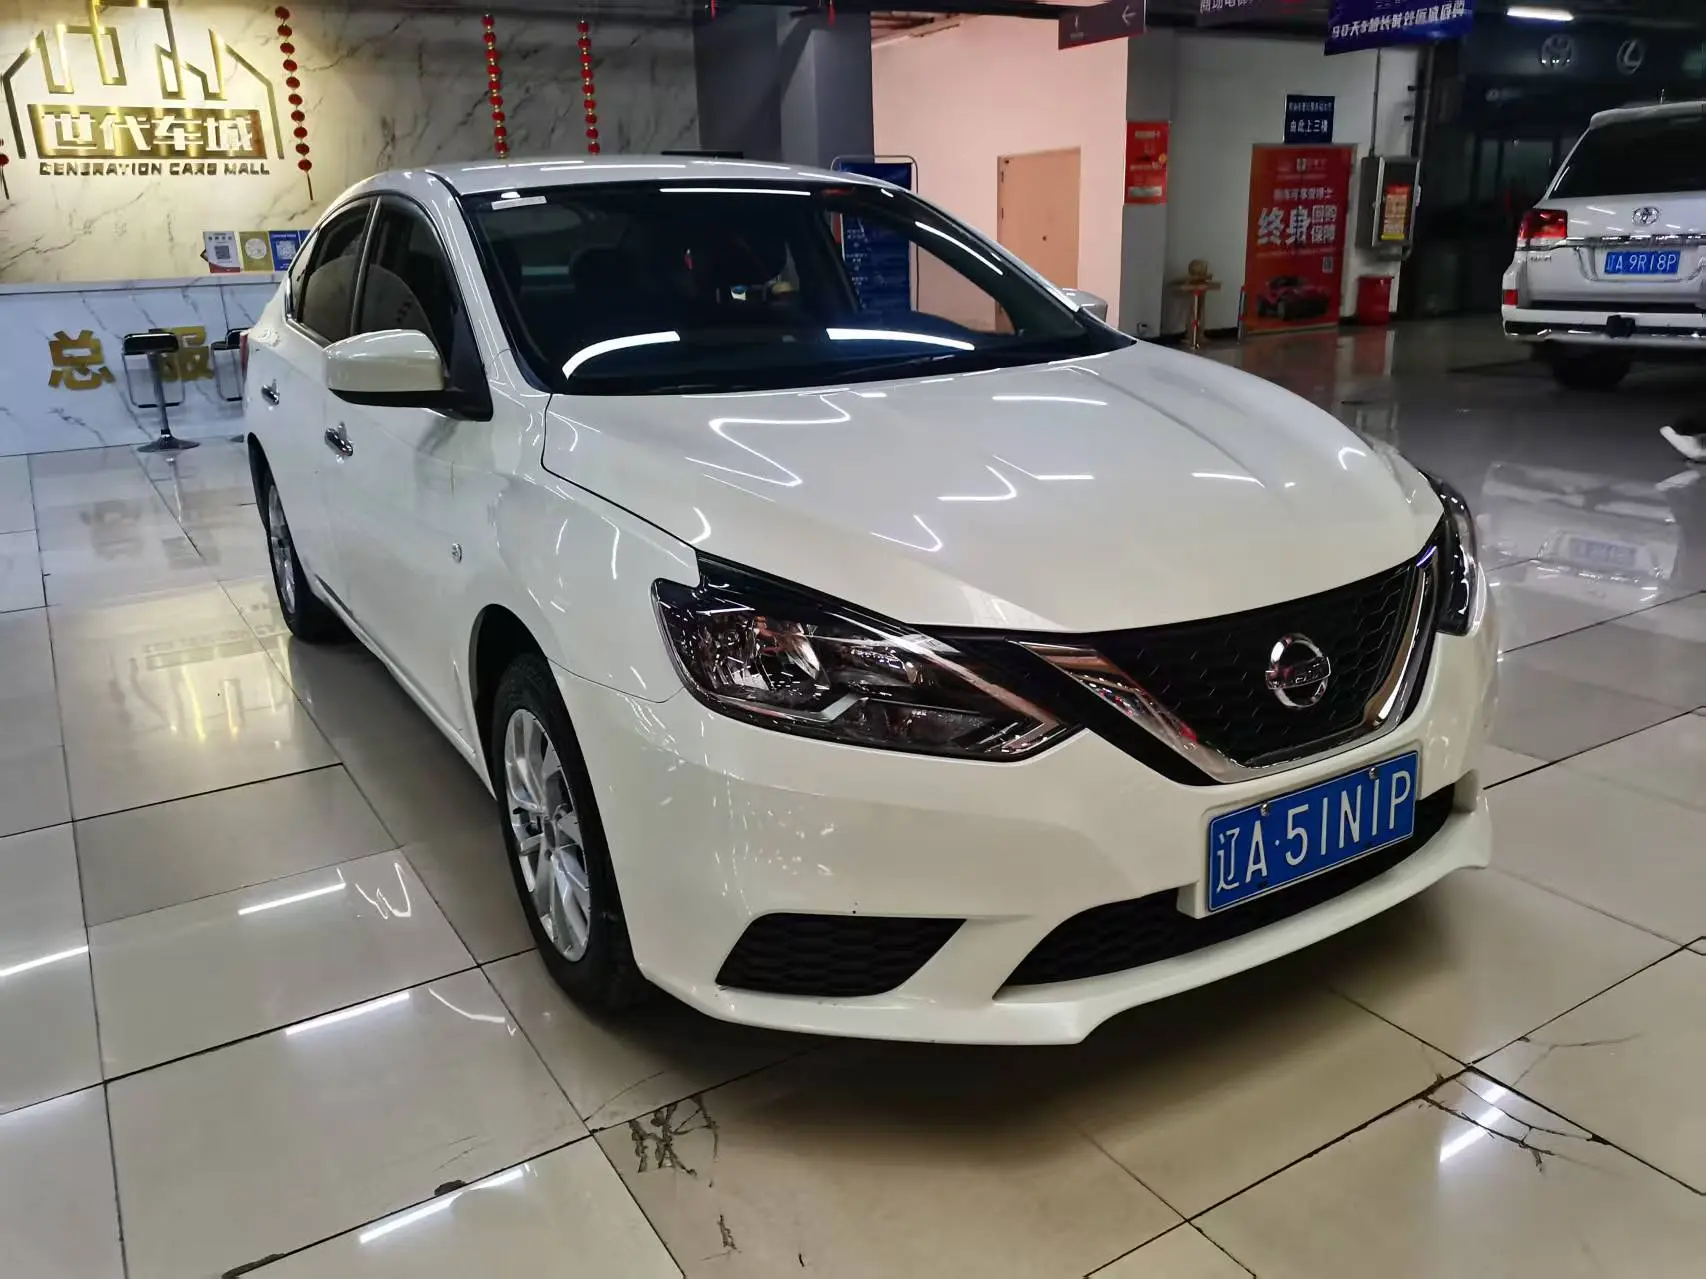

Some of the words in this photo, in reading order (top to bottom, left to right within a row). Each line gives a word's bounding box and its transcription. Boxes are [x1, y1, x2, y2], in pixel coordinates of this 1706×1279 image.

[41, 112, 253, 151] 世代车城
[224, 163, 270, 176] MALL
[1256, 204, 1312, 246] 终身
[1311, 224, 1337, 244] 保障
